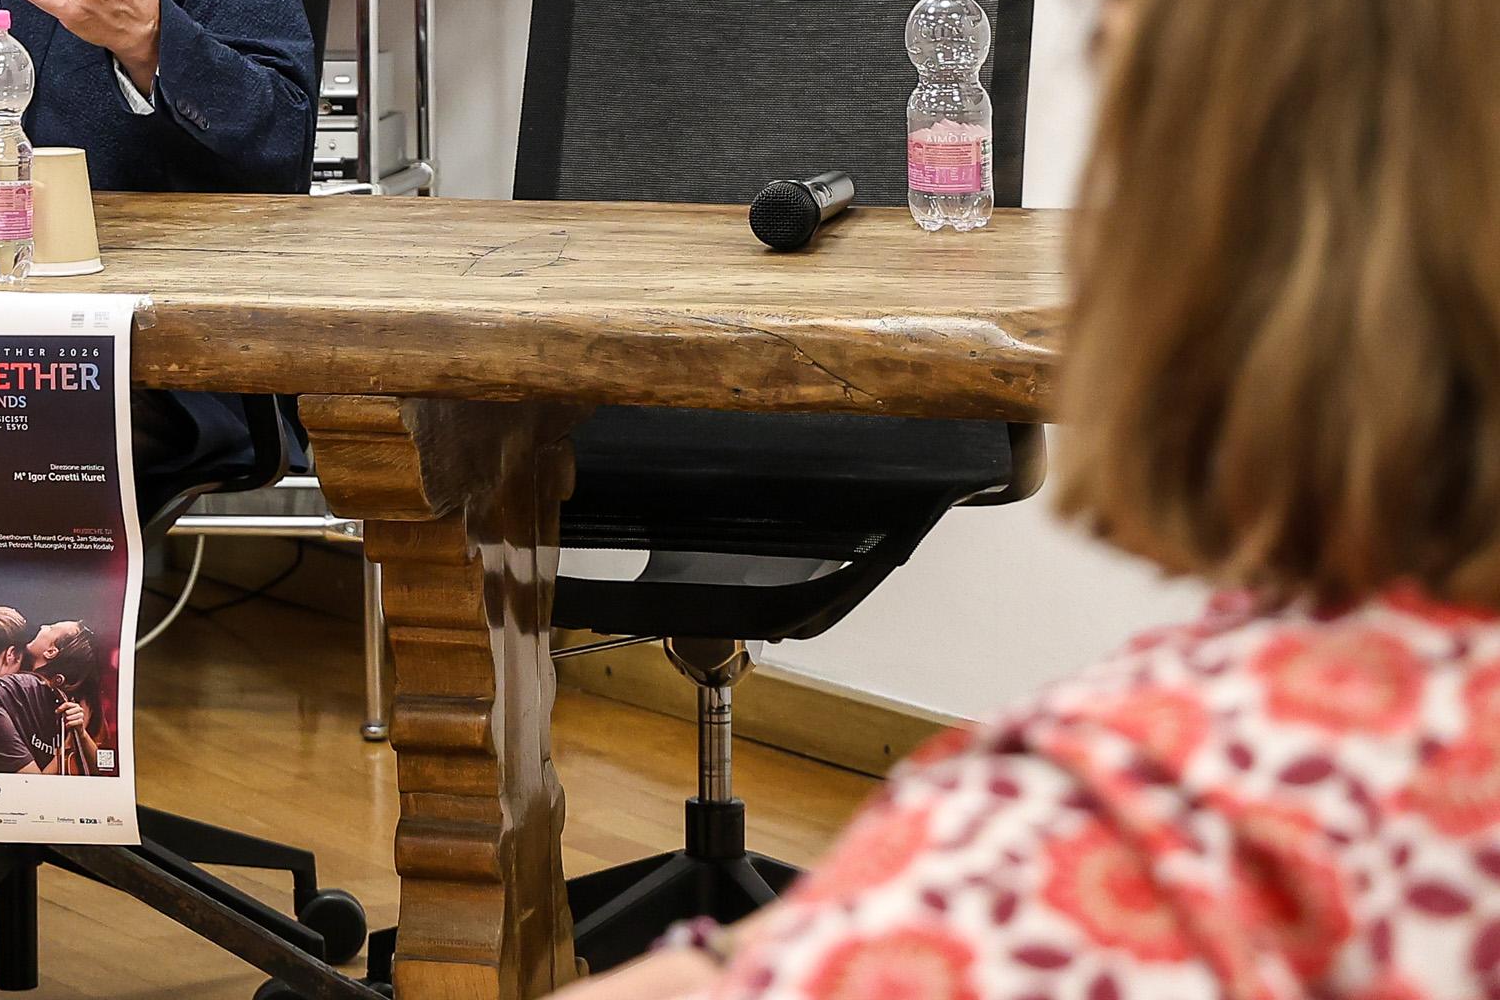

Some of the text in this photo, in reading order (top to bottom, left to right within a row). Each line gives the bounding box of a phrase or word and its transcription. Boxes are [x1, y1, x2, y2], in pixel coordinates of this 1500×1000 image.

[59, 348, 100, 357] 2026
[6, 423, 29, 431] ESYO
[28, 472, 46, 483] Igor
[48, 472, 79, 482] Coretti
[81, 473, 105, 482] Kuret
